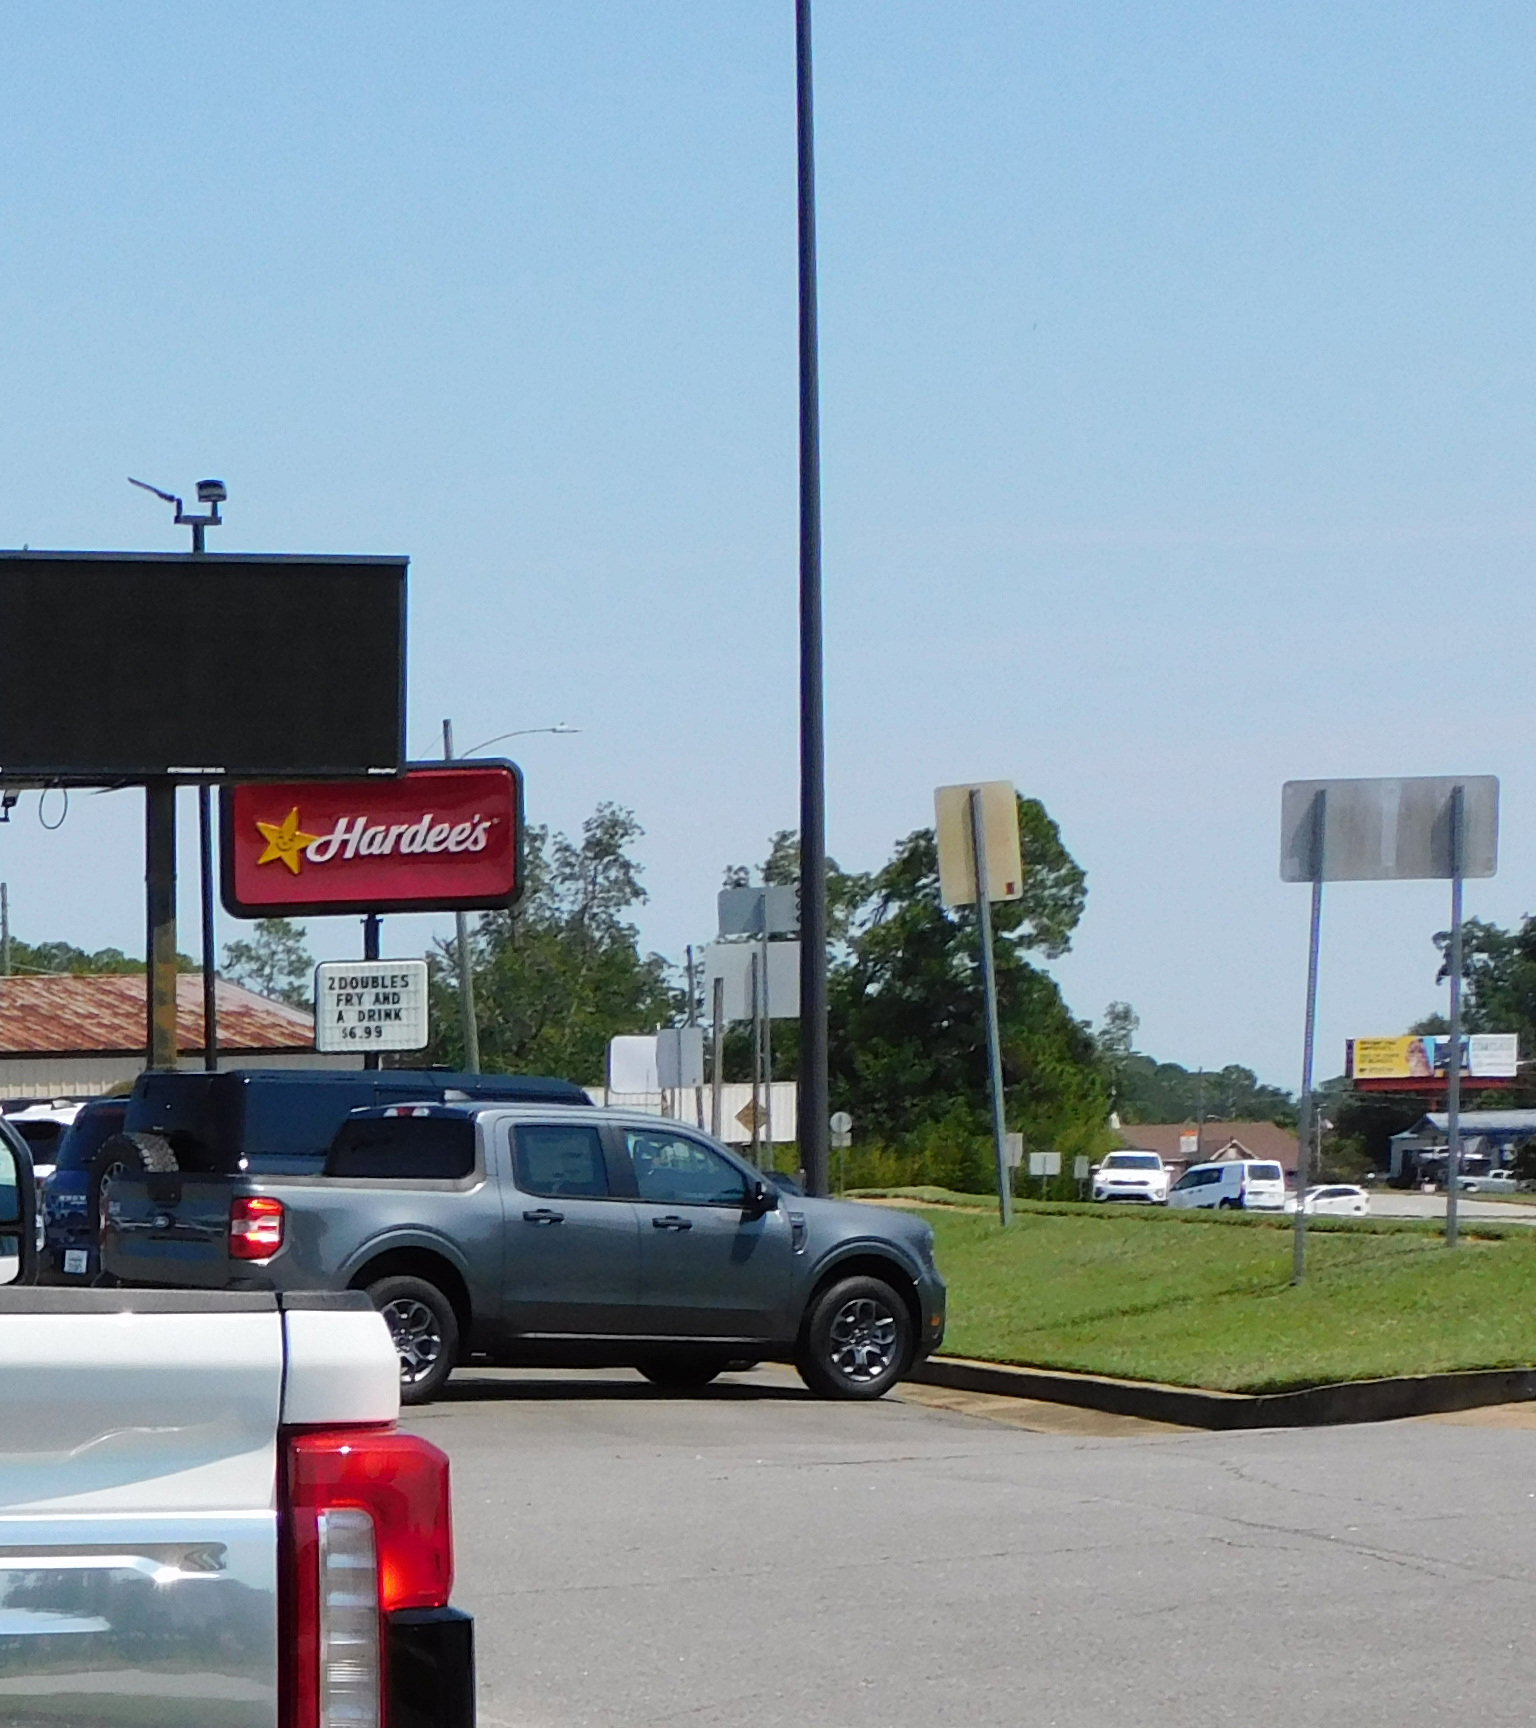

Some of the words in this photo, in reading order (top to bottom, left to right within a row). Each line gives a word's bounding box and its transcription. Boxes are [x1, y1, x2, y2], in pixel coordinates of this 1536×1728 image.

[306, 813, 492, 863] Hardee's
[336, 992, 365, 1007] FRY
[372, 991, 401, 1006] AND
[336, 1010, 345, 1024] A
[357, 1008, 403, 1023] DRINK
[341, 1025, 383, 1040] $6.99
